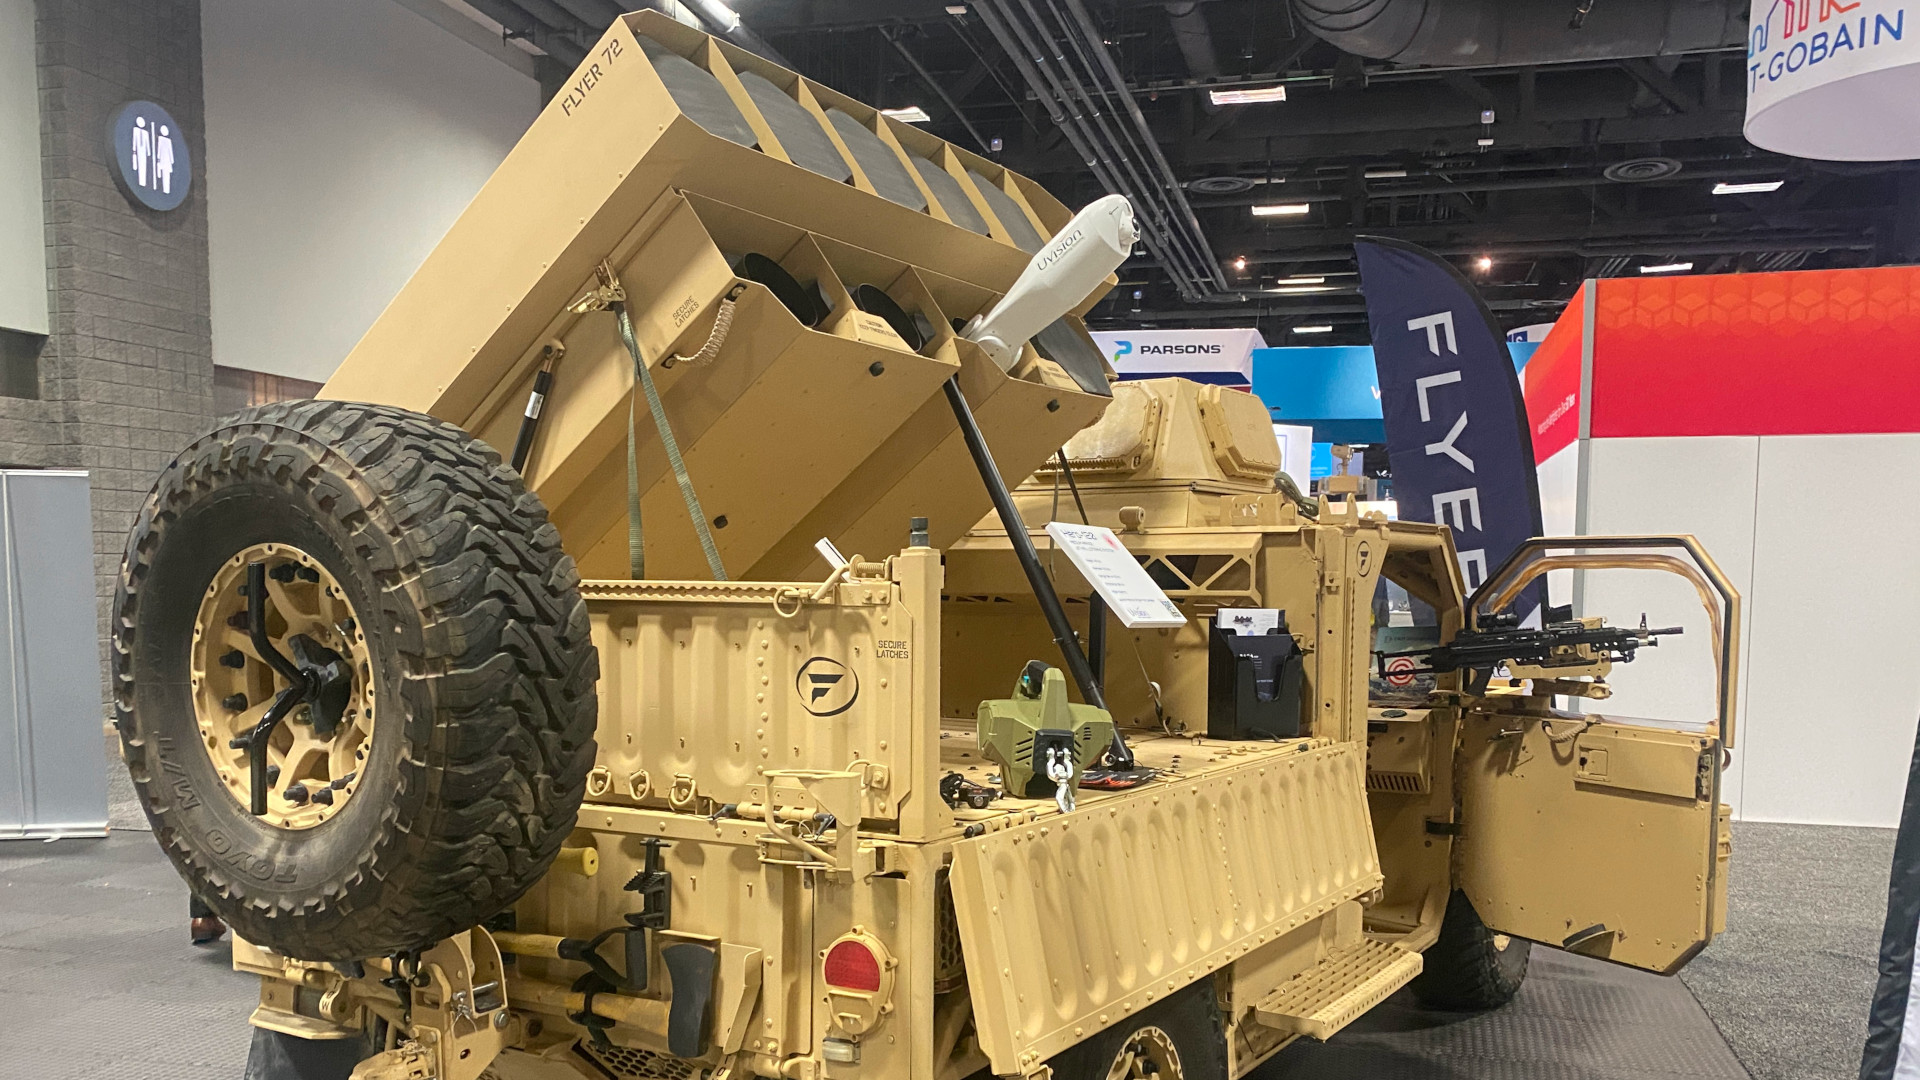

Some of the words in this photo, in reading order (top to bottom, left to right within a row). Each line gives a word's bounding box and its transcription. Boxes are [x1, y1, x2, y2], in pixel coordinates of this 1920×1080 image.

[561, 63, 604, 117] FLYER
[601, 38, 624, 66] 72
[672, 295, 695, 321] SECURE
[674, 301, 700, 328] LATCHES
[1140, 344, 1221, 355] PARSONS
[876, 650, 909, 660] LATCHES
[878, 639, 907, 650] SECURE
[204, 829, 298, 884] TOYO
